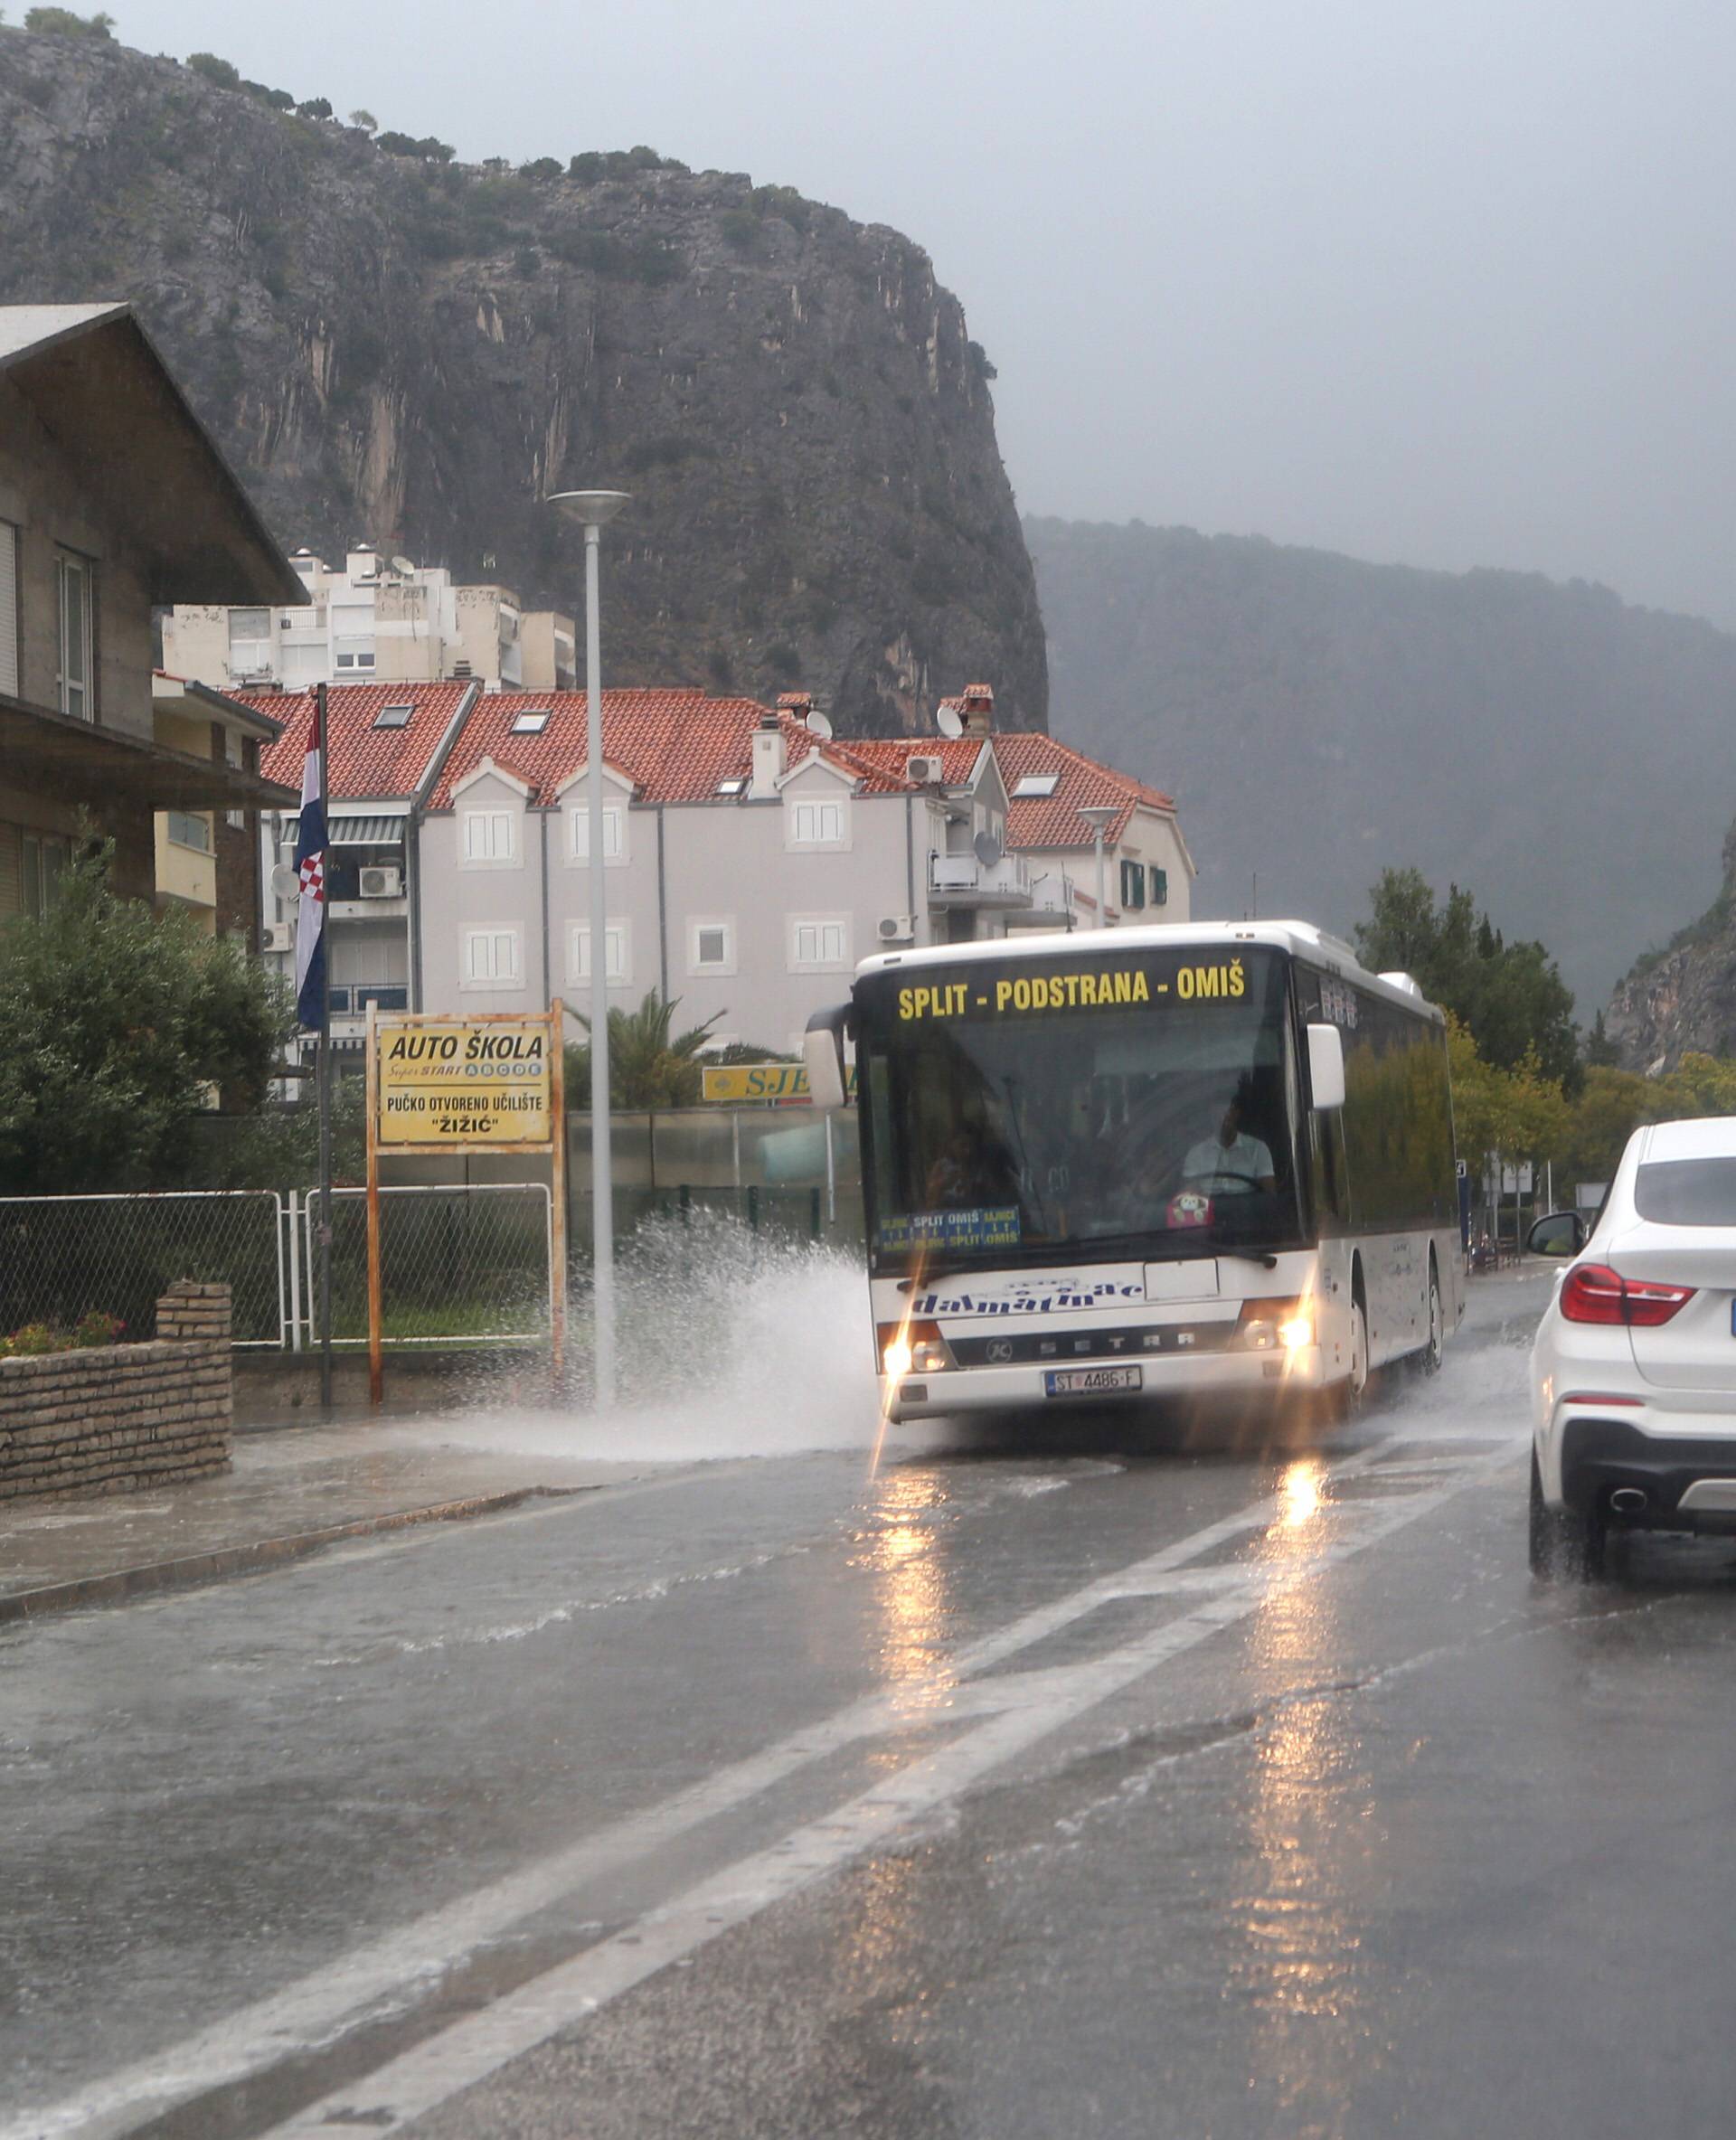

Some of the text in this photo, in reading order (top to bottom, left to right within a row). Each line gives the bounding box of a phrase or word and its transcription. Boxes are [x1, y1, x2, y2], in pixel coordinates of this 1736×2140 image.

[898, 984, 967, 1020] SPLIT
[995, 970, 1149, 1012] PODSTRANA
[1177, 958, 1245, 999] OMIŠ
[388, 1030, 542, 1060] AUTO ŠKOLA
[420, 1066, 461, 1077] START
[387, 1092, 542, 1112] PUČKO OTVORENO UČILIŠTE
[913, 1214, 944, 1228] SPLIT
[948, 1210, 979, 1224] OMIŠ
[949, 1234, 980, 1247] SPLIT
[1041, 1332, 1194, 1354] SETRA
[1056, 1374, 1072, 1390] ST
